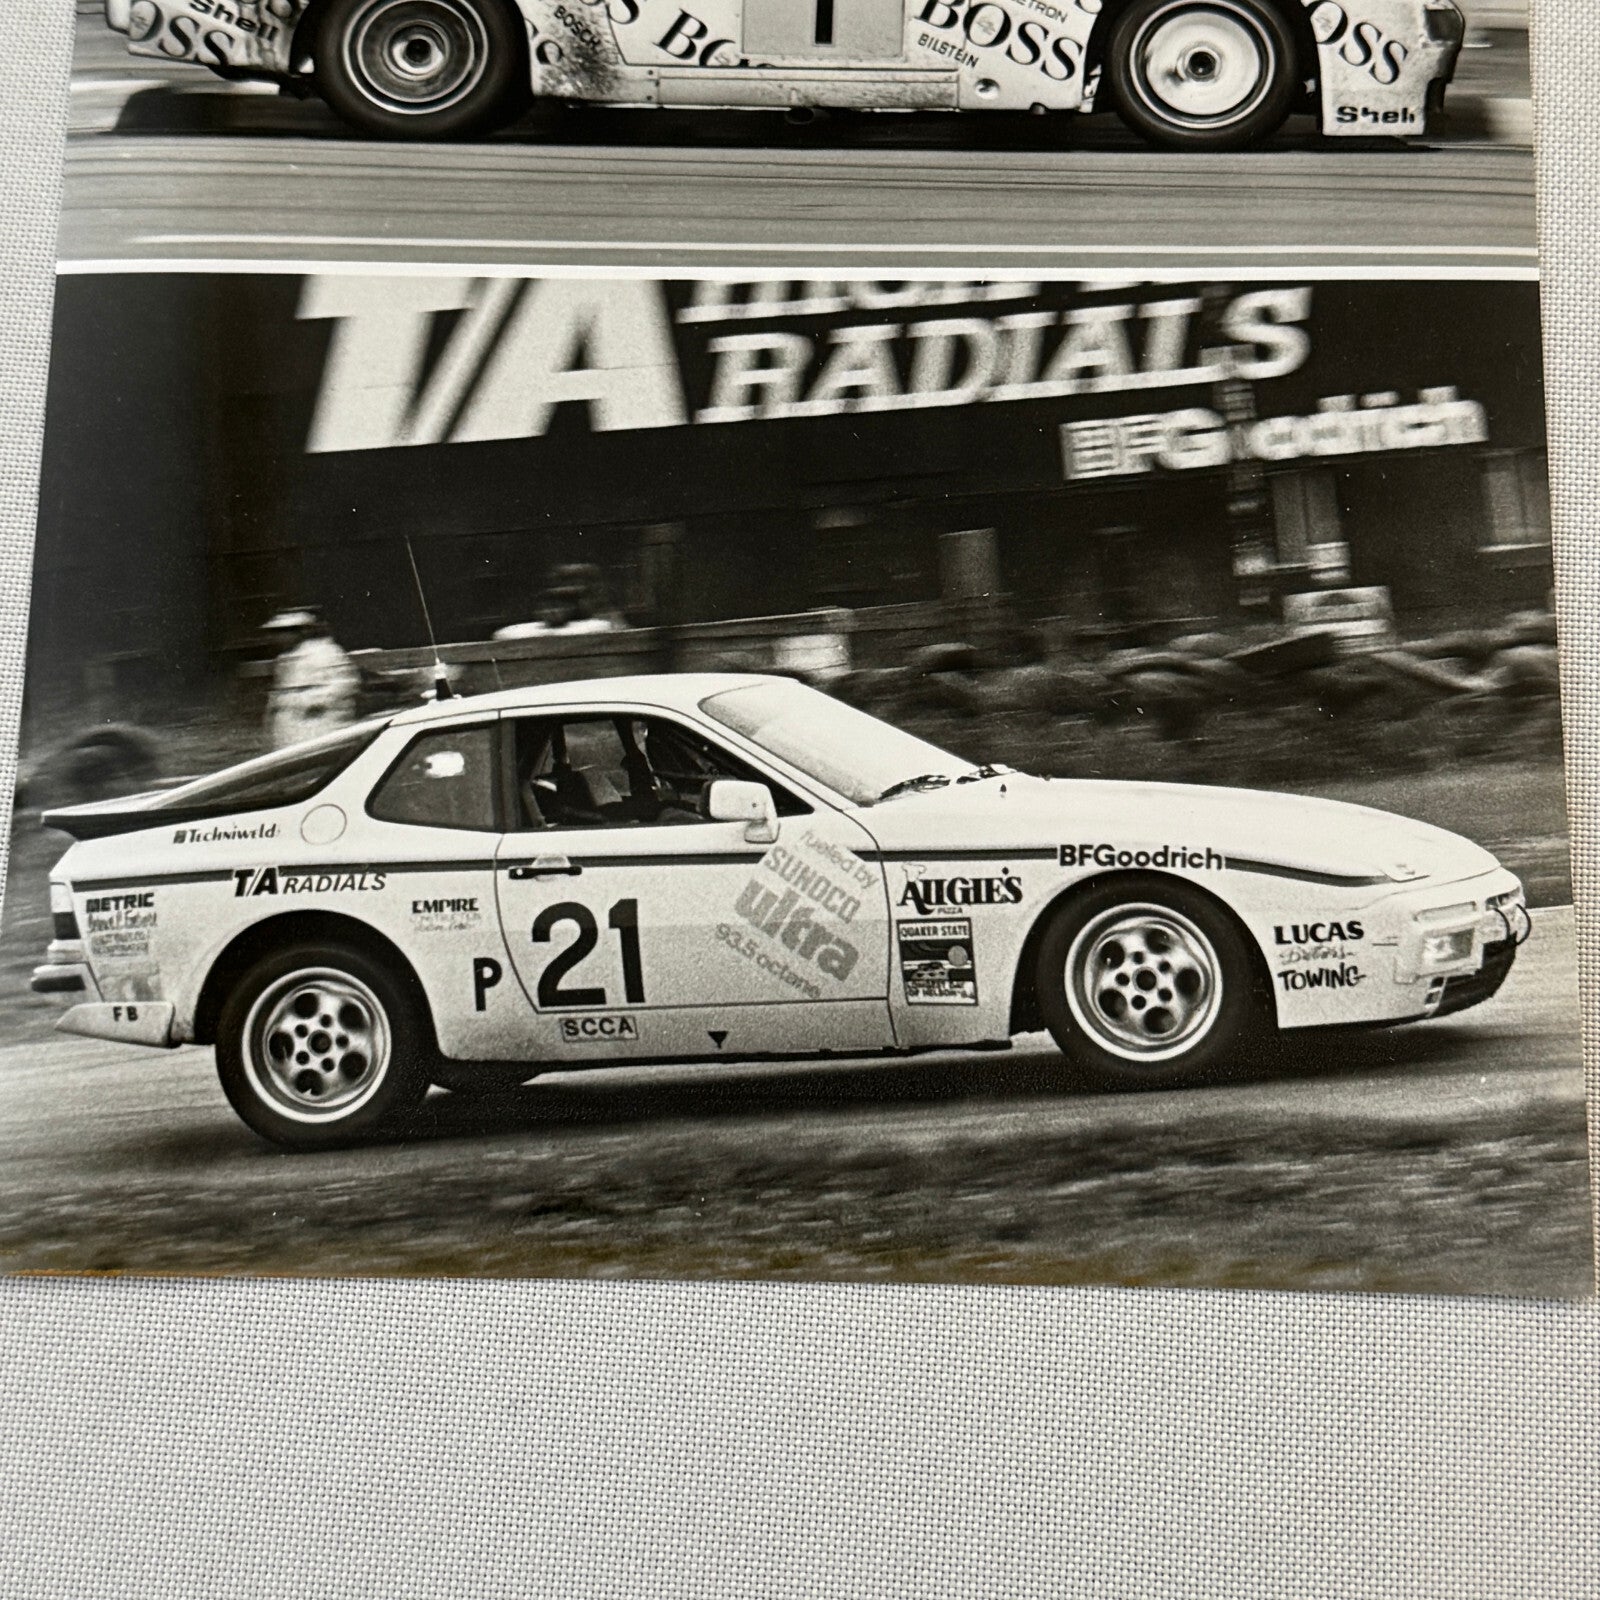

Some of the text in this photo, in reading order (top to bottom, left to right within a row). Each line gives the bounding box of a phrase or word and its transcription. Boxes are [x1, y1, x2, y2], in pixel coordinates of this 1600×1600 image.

[917, 33, 979, 68] BILSTEIN
[695, 286, 1312, 424] RADIALS
[189, 823, 276, 843] Techniweld
[1060, 844, 1223, 870] BFGoodrich
[234, 867, 387, 897] T/A RADIALS
[763, 846, 861, 924] SUNOCO
[854, 864, 881, 890] by
[86, 892, 155, 913] METRIC
[412, 898, 479, 914] EMPIRE
[734, 879, 859, 982] ultra
[901, 925, 969, 938] QUAKER STATE
[1273, 920, 1365, 945] LUCAS
[531, 898, 645, 1008] 21
[473, 957, 503, 1012] P
[1277, 962, 1366, 991] TOWING
[563, 1018, 633, 1037] SCCA
